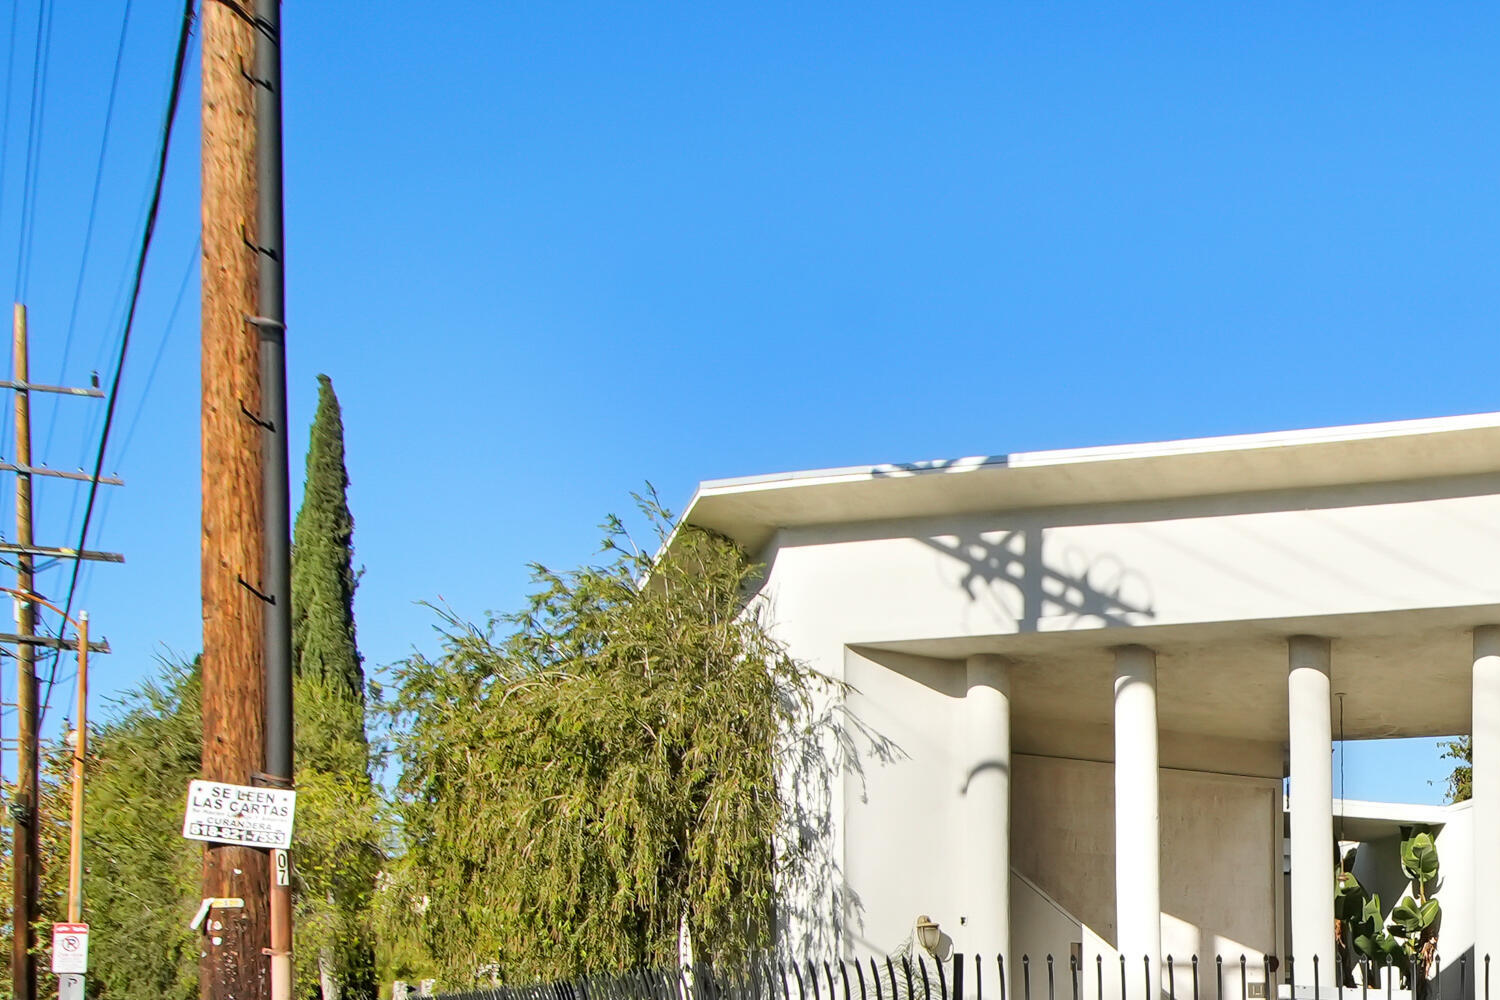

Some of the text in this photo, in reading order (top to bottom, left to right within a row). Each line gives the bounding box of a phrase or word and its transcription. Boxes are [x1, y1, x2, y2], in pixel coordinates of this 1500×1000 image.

[211, 786, 275, 804] SE LEEN
[193, 796, 223, 810] LAS
[230, 801, 288, 817] CARTAS
[206, 816, 272, 831] CURANDERA
